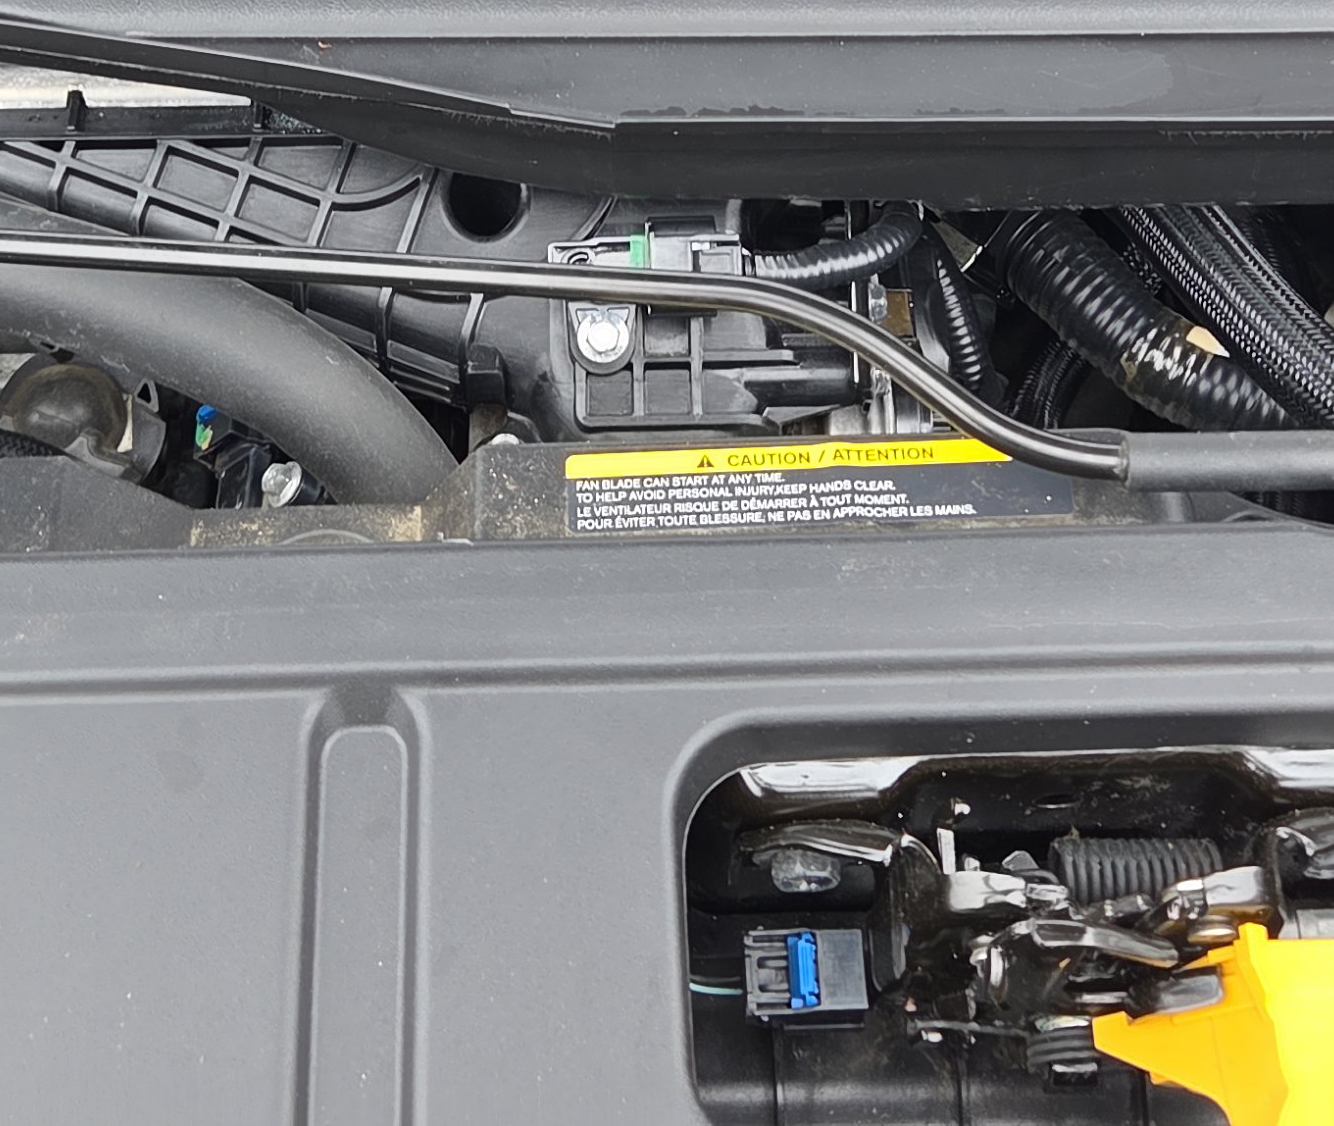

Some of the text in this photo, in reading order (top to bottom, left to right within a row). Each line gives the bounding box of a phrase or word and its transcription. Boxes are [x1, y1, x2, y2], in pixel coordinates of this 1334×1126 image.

[727, 451, 811, 467] CAUTION
[832, 447, 935, 462] ATTENTION
[576, 472, 786, 491] FAN BLADE CAN START AT ANY TIME.
[576, 492, 594, 503] TO
[595, 490, 627, 502] HELP
[629, 489, 666, 501] AVOID
[668, 486, 733, 499] PERSONAL
[809, 479, 852, 493] HANDS
[853, 479, 896, 491] CLEAR.
[576, 506, 592, 517] LE
[593, 503, 672, 517] VENTILATEUR
[673, 501, 720, 513] RISQUE
[721, 500, 739, 511] DE
[740, 496, 808, 511] DÉMARRER
[820, 494, 852, 506] TOUT
[854, 493, 910, 506] MOMENT.
[577, 518, 614, 530] POUR
[657, 515, 698, 527] TOUTE
[767, 511, 785, 522] NE
[786, 509, 812, 522] PAS
[813, 509, 831, 520] EN
[832, 505, 909, 519] APPROCHER
[909, 505, 933, 517] LES
[934, 504, 978, 516] MAINS.
